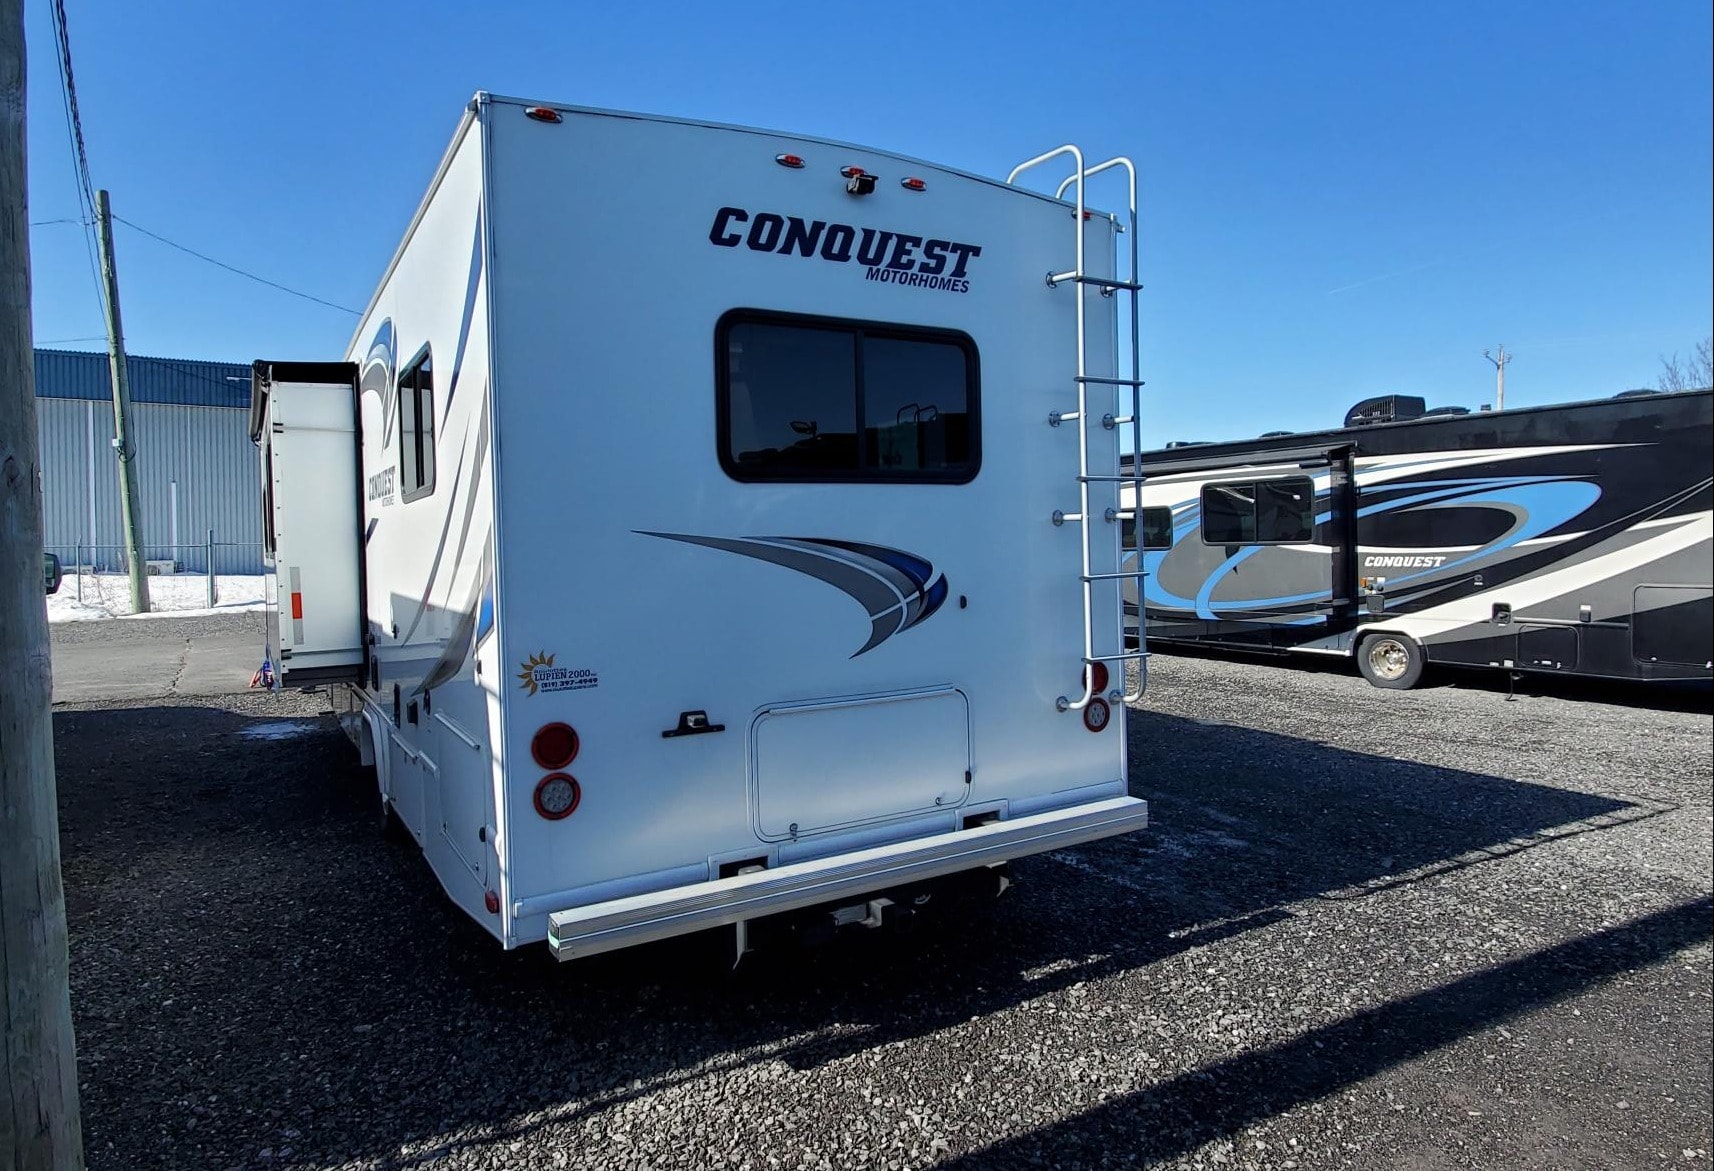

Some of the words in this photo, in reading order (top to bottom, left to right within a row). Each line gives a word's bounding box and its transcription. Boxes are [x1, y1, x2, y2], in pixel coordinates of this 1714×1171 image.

[709, 206, 982, 278] CONQUEST
[865, 266, 970, 293] MOTORHOMES
[1364, 556, 1446, 567] CONQUEST
[534, 671, 567, 682] LUPIEN
[568, 669, 591, 679] 2000
